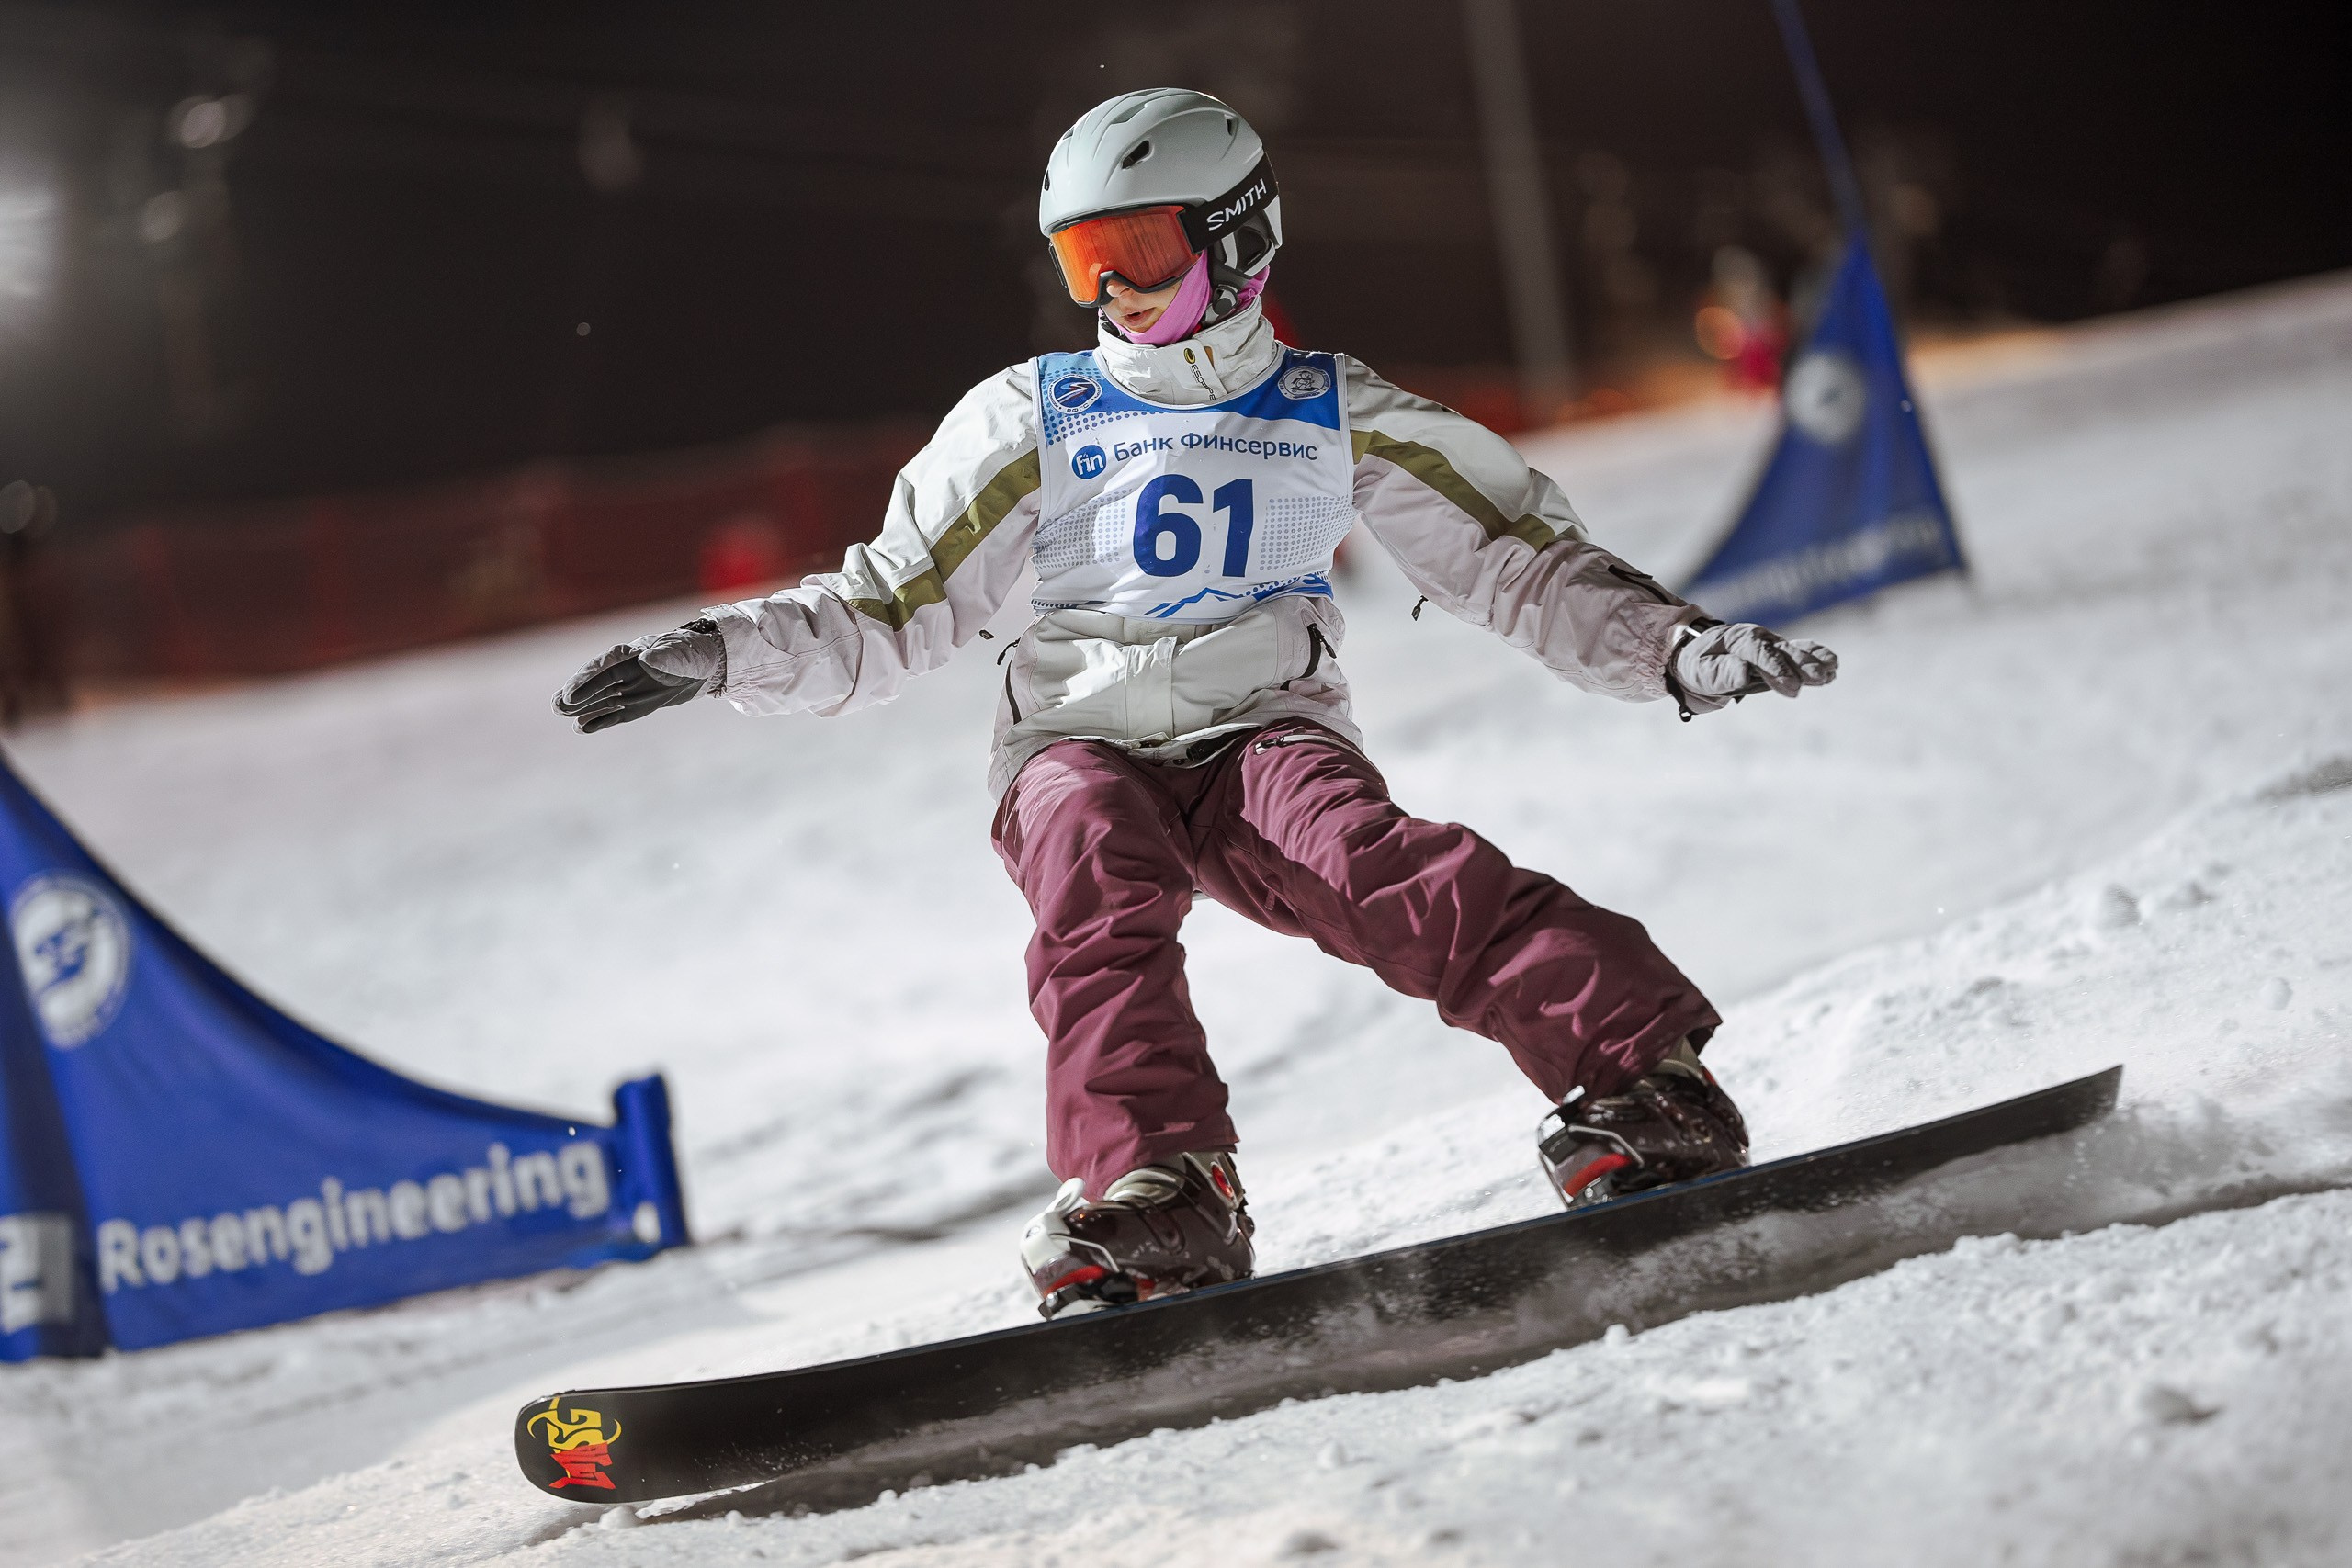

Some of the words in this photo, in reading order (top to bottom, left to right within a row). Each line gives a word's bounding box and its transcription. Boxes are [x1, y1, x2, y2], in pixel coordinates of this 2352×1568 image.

[1206, 178, 1267, 231] SMITH
[1076, 452, 1104, 476] fin
[1114, 437, 1174, 462] Банк
[1180, 432, 1318, 461] Финсервис
[1133, 473, 1254, 578] 61
[97, 1141, 613, 1292] Rosengineering
